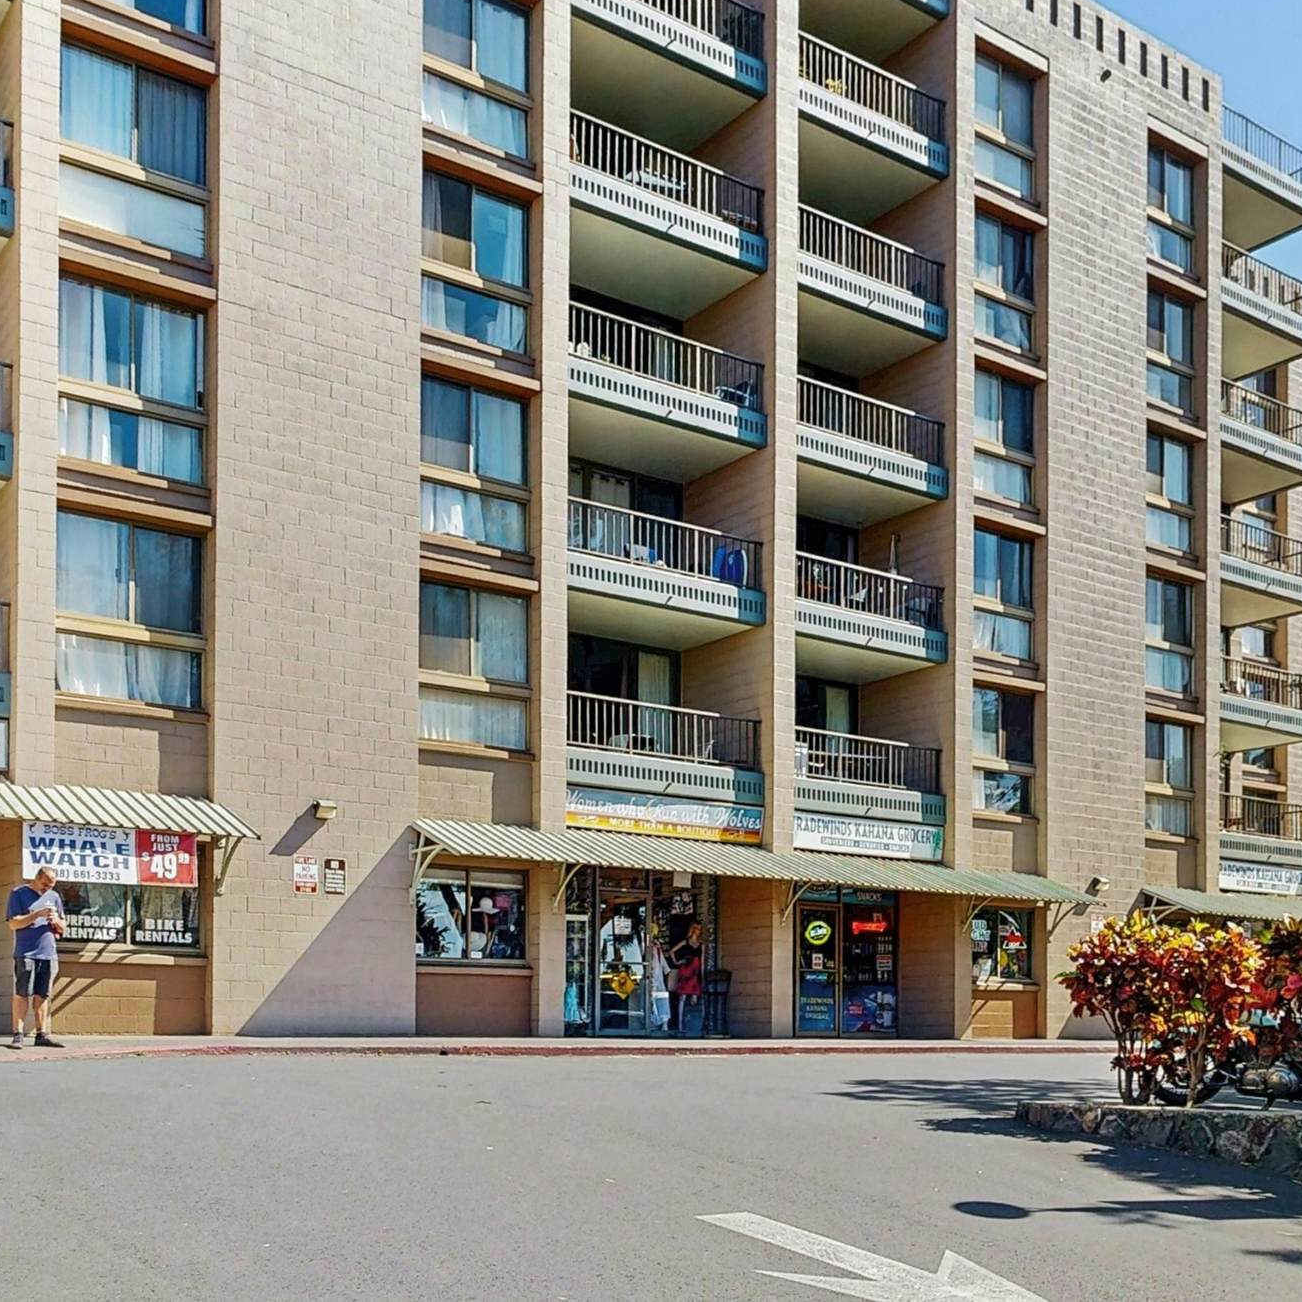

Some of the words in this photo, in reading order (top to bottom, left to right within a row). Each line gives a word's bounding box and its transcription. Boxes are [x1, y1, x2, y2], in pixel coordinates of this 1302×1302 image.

[681, 805, 709, 824] with
[714, 807, 762, 830] Wolves
[43, 824, 75, 836] BOSS
[78, 827, 117, 840] FROG'S
[639, 820, 663, 832] THAN
[667, 823, 675, 833] A
[795, 816, 851, 836] RADEWINDS
[854, 821, 895, 841] KAHANA
[29, 836, 131, 856] WHALE
[151, 834, 180, 844] FROM
[152, 841, 179, 852] JUST
[29, 850, 130, 870] WATCH
[73, 869, 121, 881] 661-3333
[65, 914, 124, 929] URFBOARD
[145, 918, 184, 931] BIKE
[62, 927, 118, 941] RENTALS
[136, 930, 193, 944] RENTALS
